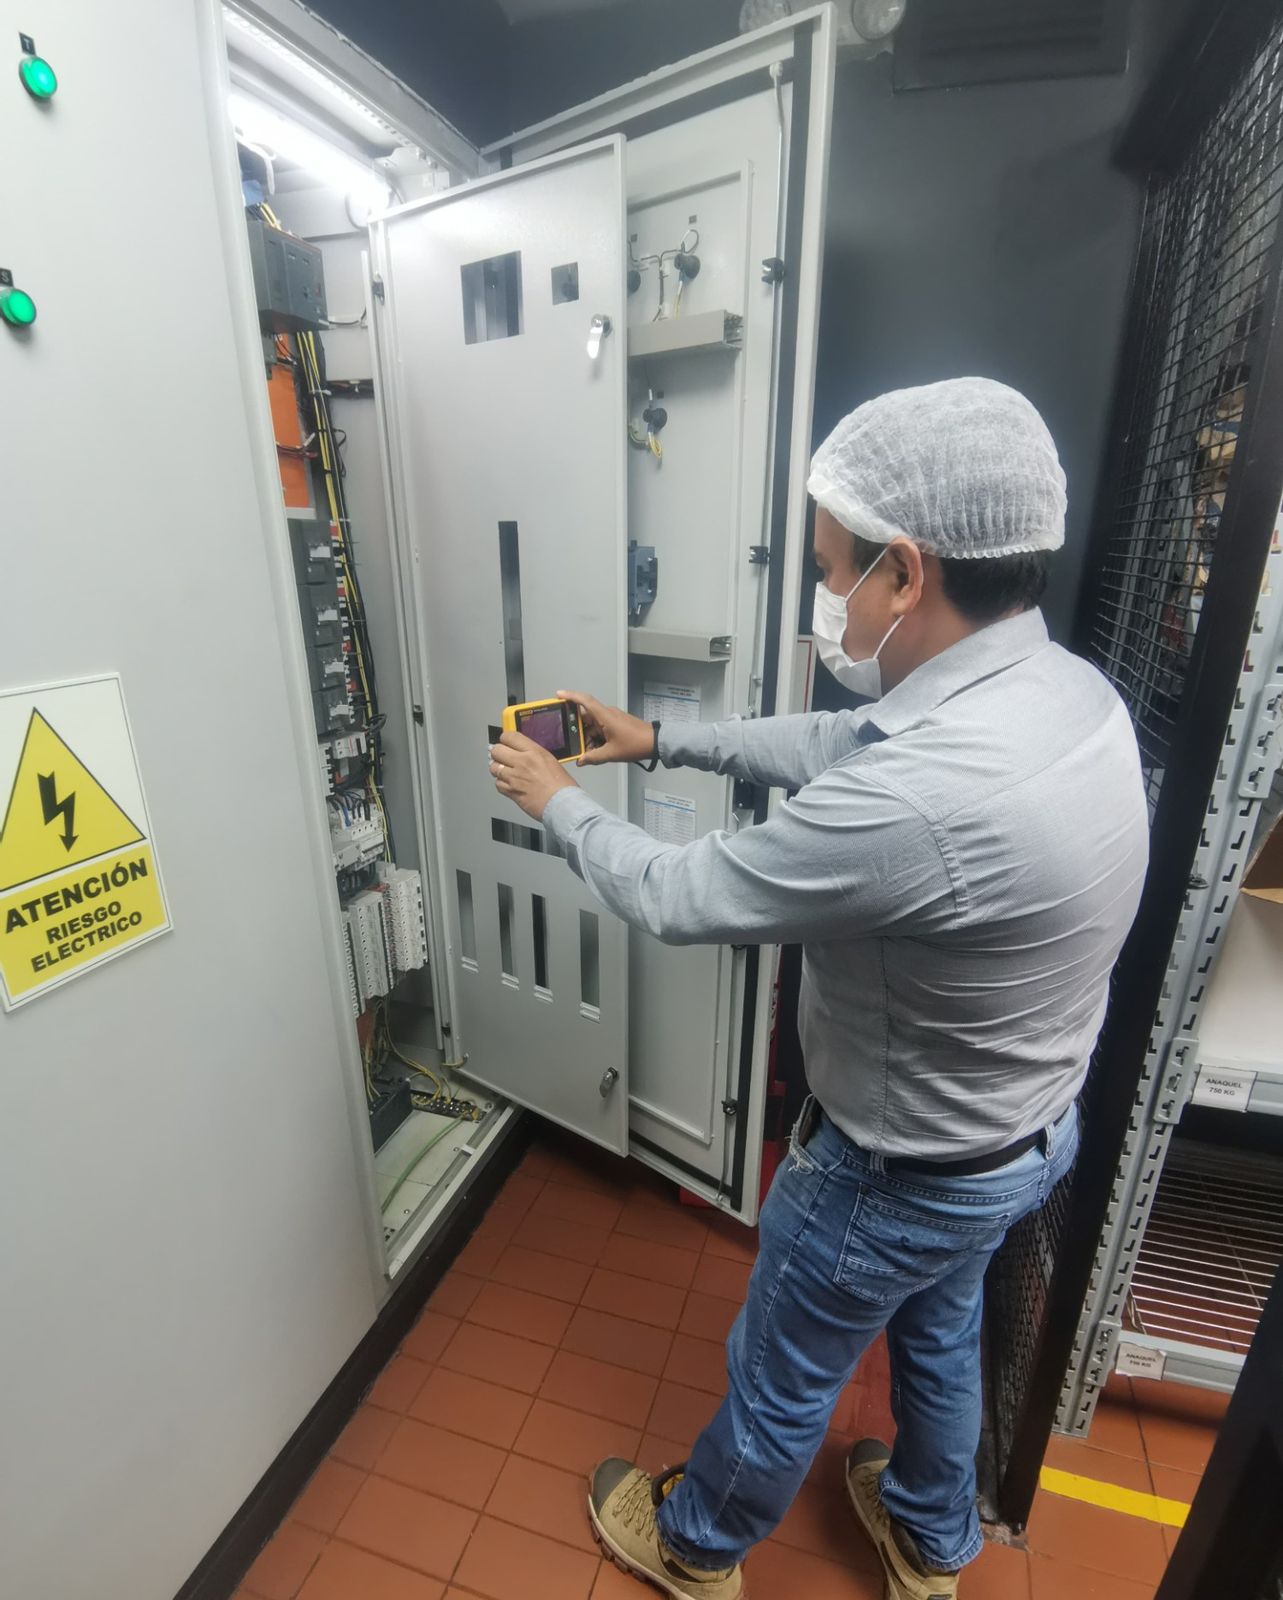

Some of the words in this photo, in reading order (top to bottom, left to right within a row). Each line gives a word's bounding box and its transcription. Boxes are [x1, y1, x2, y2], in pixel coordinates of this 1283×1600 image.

[5, 858, 148, 934] ATENCIÓN
[31, 911, 142, 973] ELECTRICO
[46, 901, 122, 944] RIESGO
[1206, 1078, 1242, 1088] ANAQUEL
